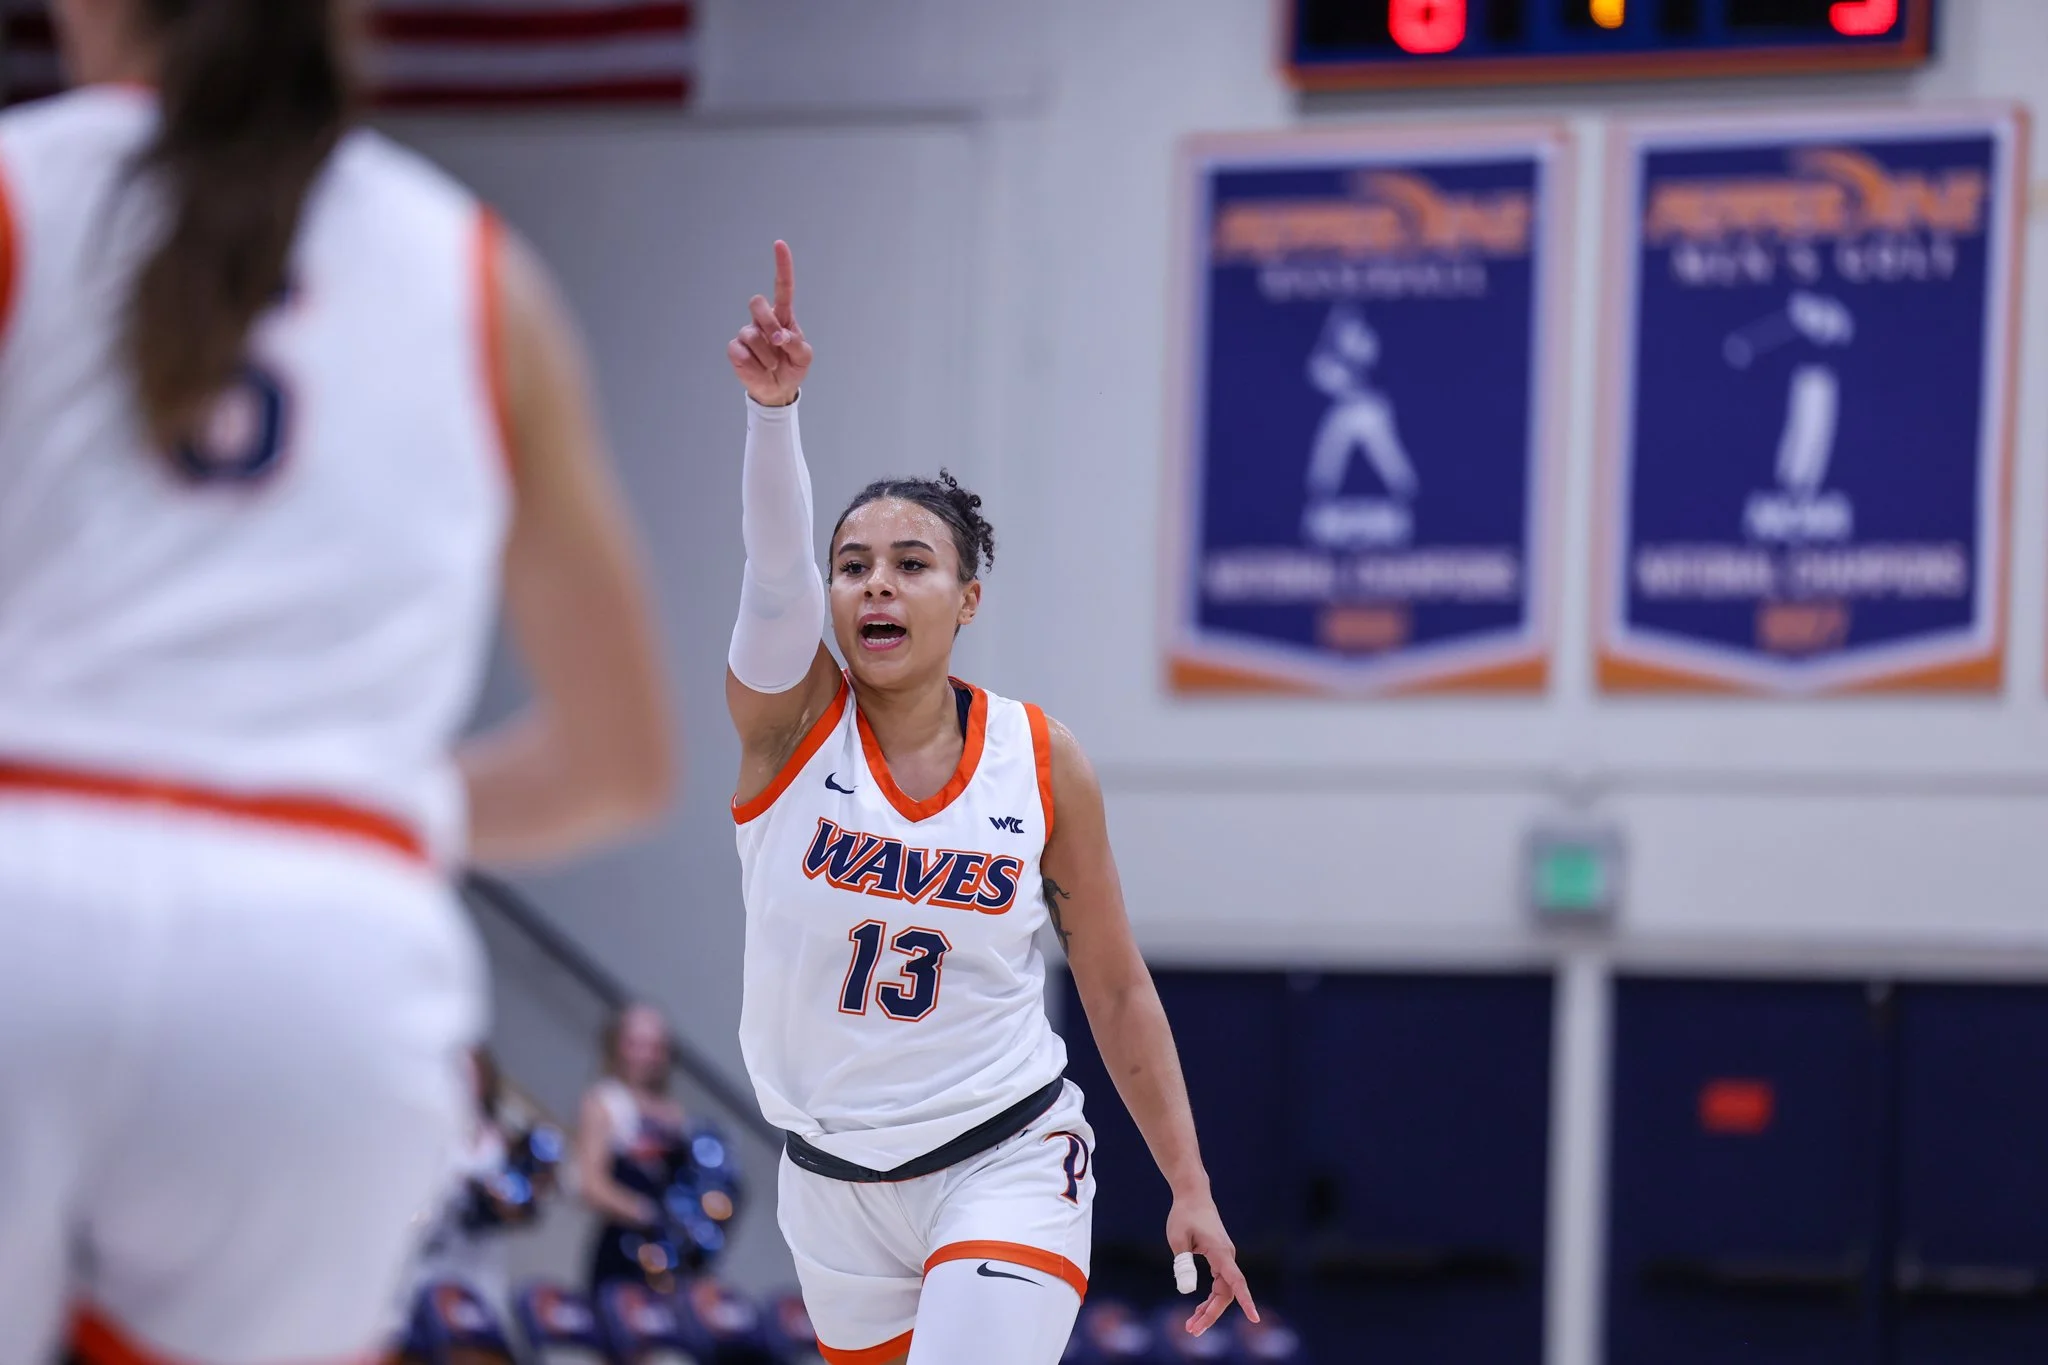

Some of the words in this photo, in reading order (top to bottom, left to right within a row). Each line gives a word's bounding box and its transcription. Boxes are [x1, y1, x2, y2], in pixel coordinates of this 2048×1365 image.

[802, 816, 1024, 915] WAVES
[838, 918, 953, 1023] 13
[1043, 1130, 1089, 1206] P
